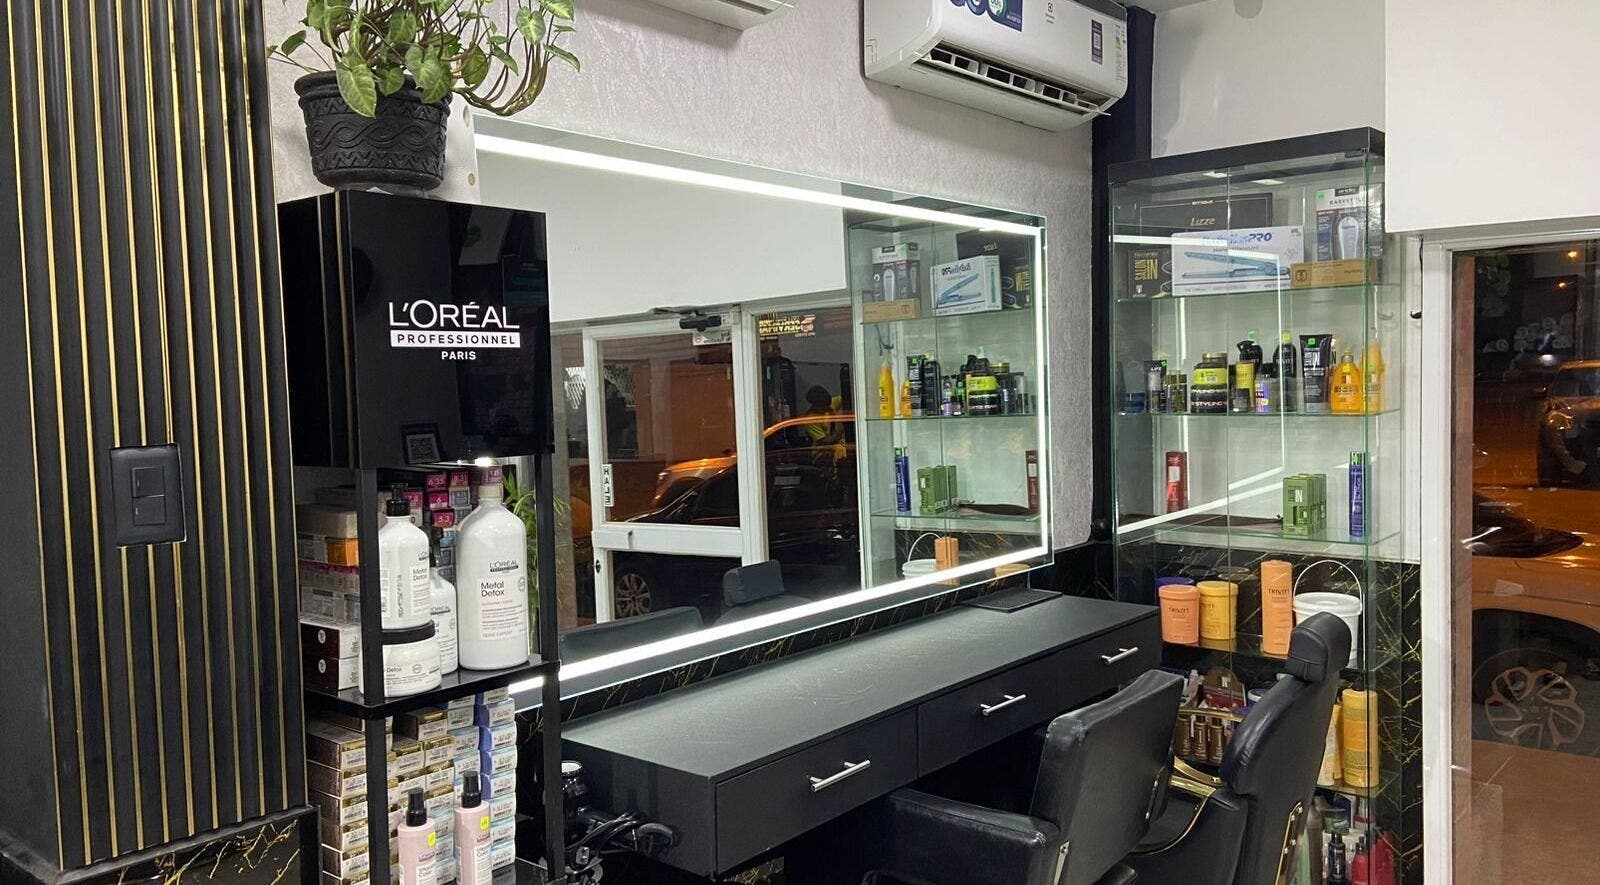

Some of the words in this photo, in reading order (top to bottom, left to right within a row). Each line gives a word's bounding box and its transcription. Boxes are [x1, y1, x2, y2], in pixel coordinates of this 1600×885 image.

[388, 299, 520, 329] L'ORÉAL
[397, 334, 516, 344] PROFESSIONNEL
[441, 350, 477, 360] PARIS
[481, 581, 505, 589] Metal
[481, 589, 505, 597] Detox
